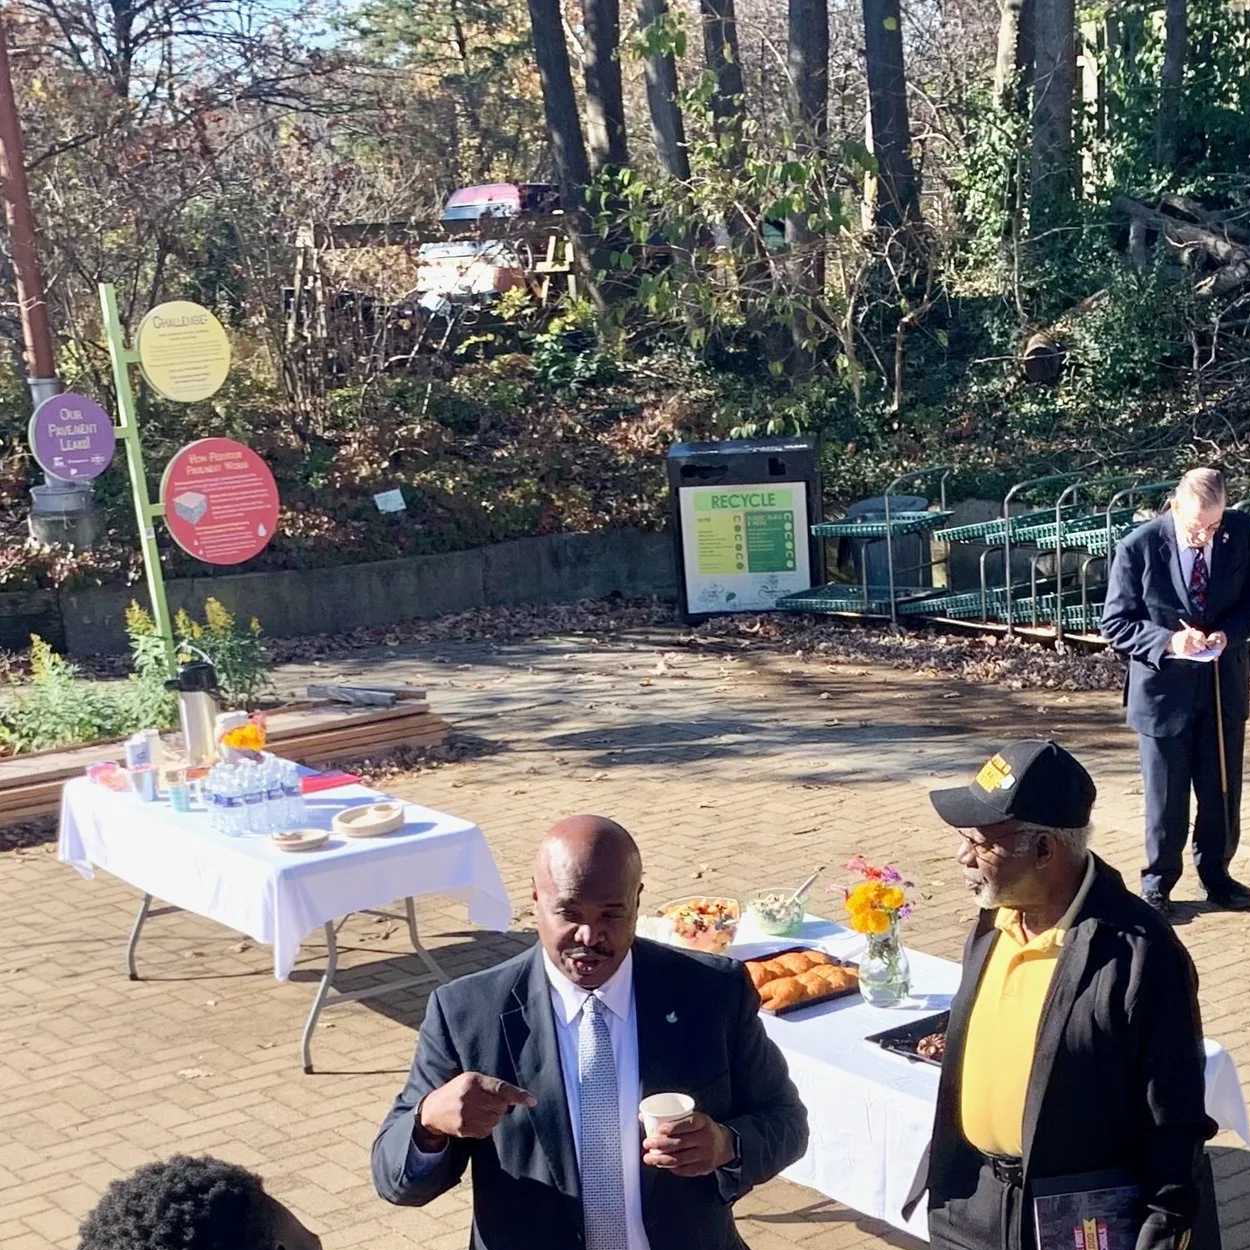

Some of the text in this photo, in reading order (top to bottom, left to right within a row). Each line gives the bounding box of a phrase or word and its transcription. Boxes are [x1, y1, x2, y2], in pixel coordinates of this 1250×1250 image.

[60, 408, 83, 421] OUR
[48, 423, 97, 437] PAVEMENT
[711, 493, 776, 509] RECYCLE
